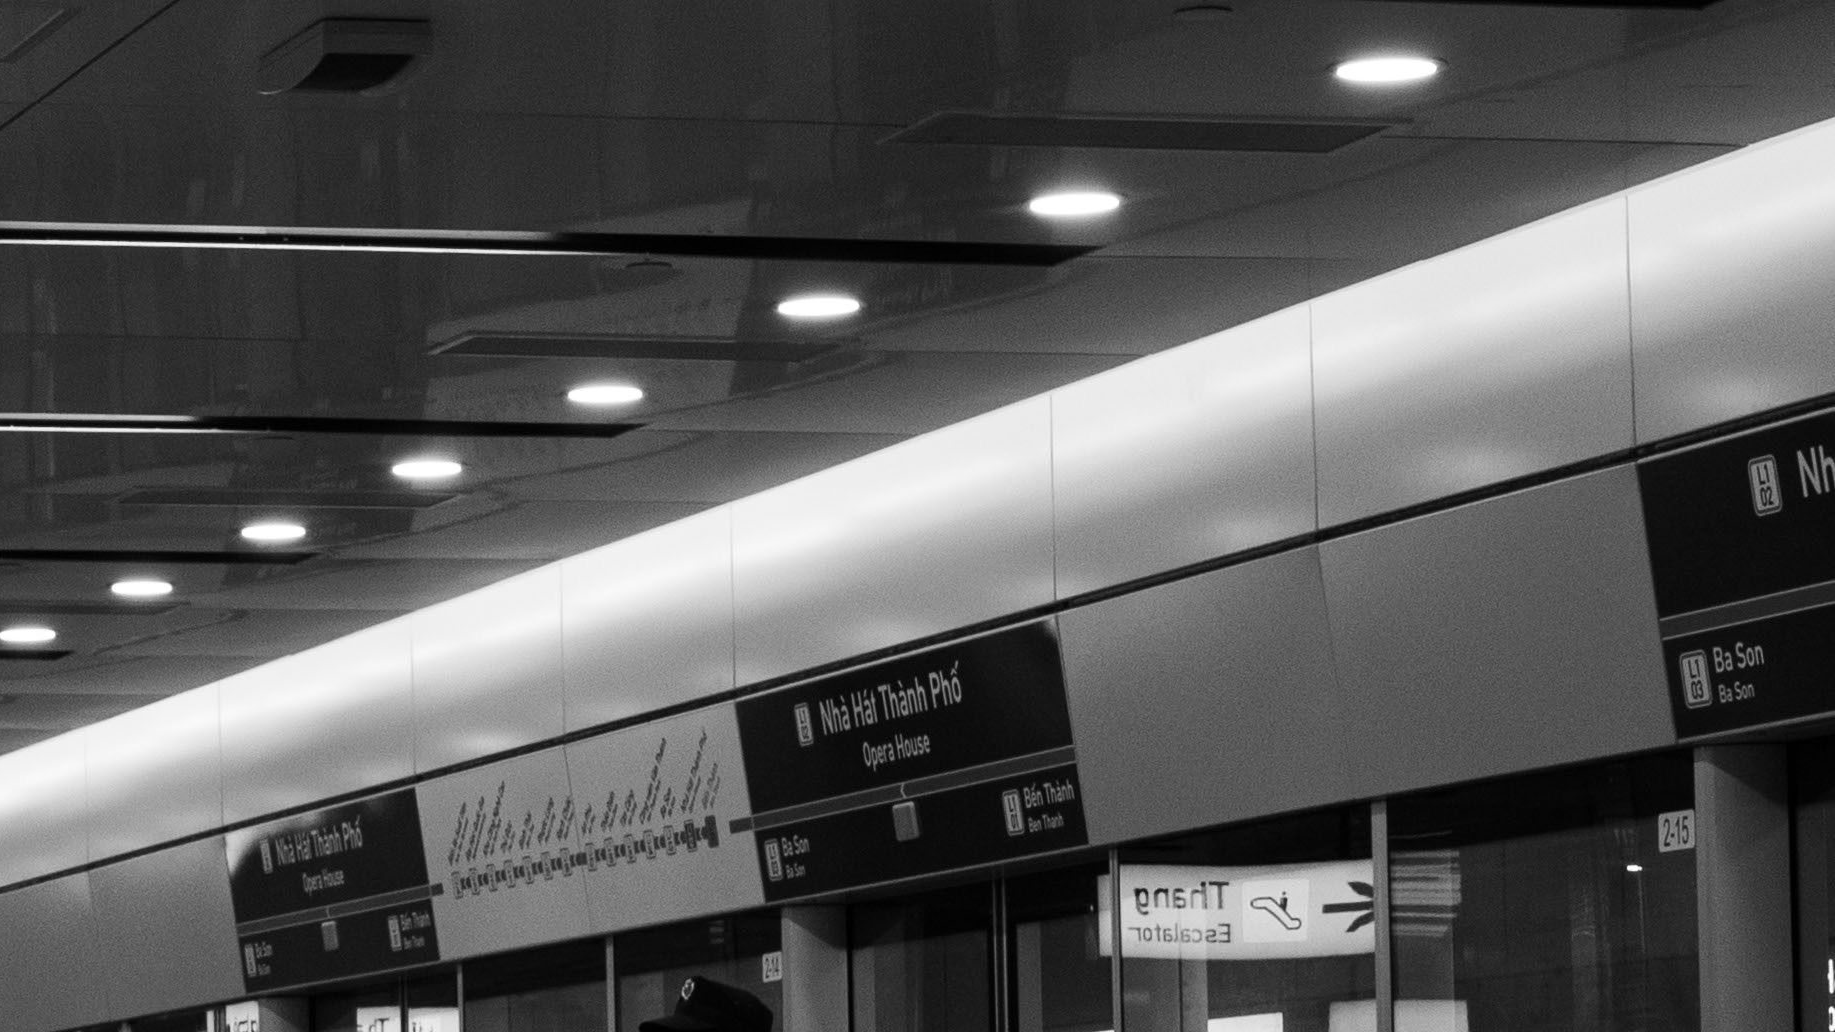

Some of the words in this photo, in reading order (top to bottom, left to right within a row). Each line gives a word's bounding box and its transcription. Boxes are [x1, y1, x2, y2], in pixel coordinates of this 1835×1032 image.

[1713, 646, 1733, 674] Ba
[1734, 641, 1765, 669] Son
[819, 694, 852, 736] Nhà
[850, 688, 879, 729] Hát
[877, 679, 929, 721] Thành
[927, 660, 963, 709] Phố
[1718, 683, 1733, 704] Ba
[1734, 681, 1756, 700] Son
[862, 741, 896, 773] Opera
[894, 733, 931, 760] House
[1663, 816, 1690, 847] 2-15
